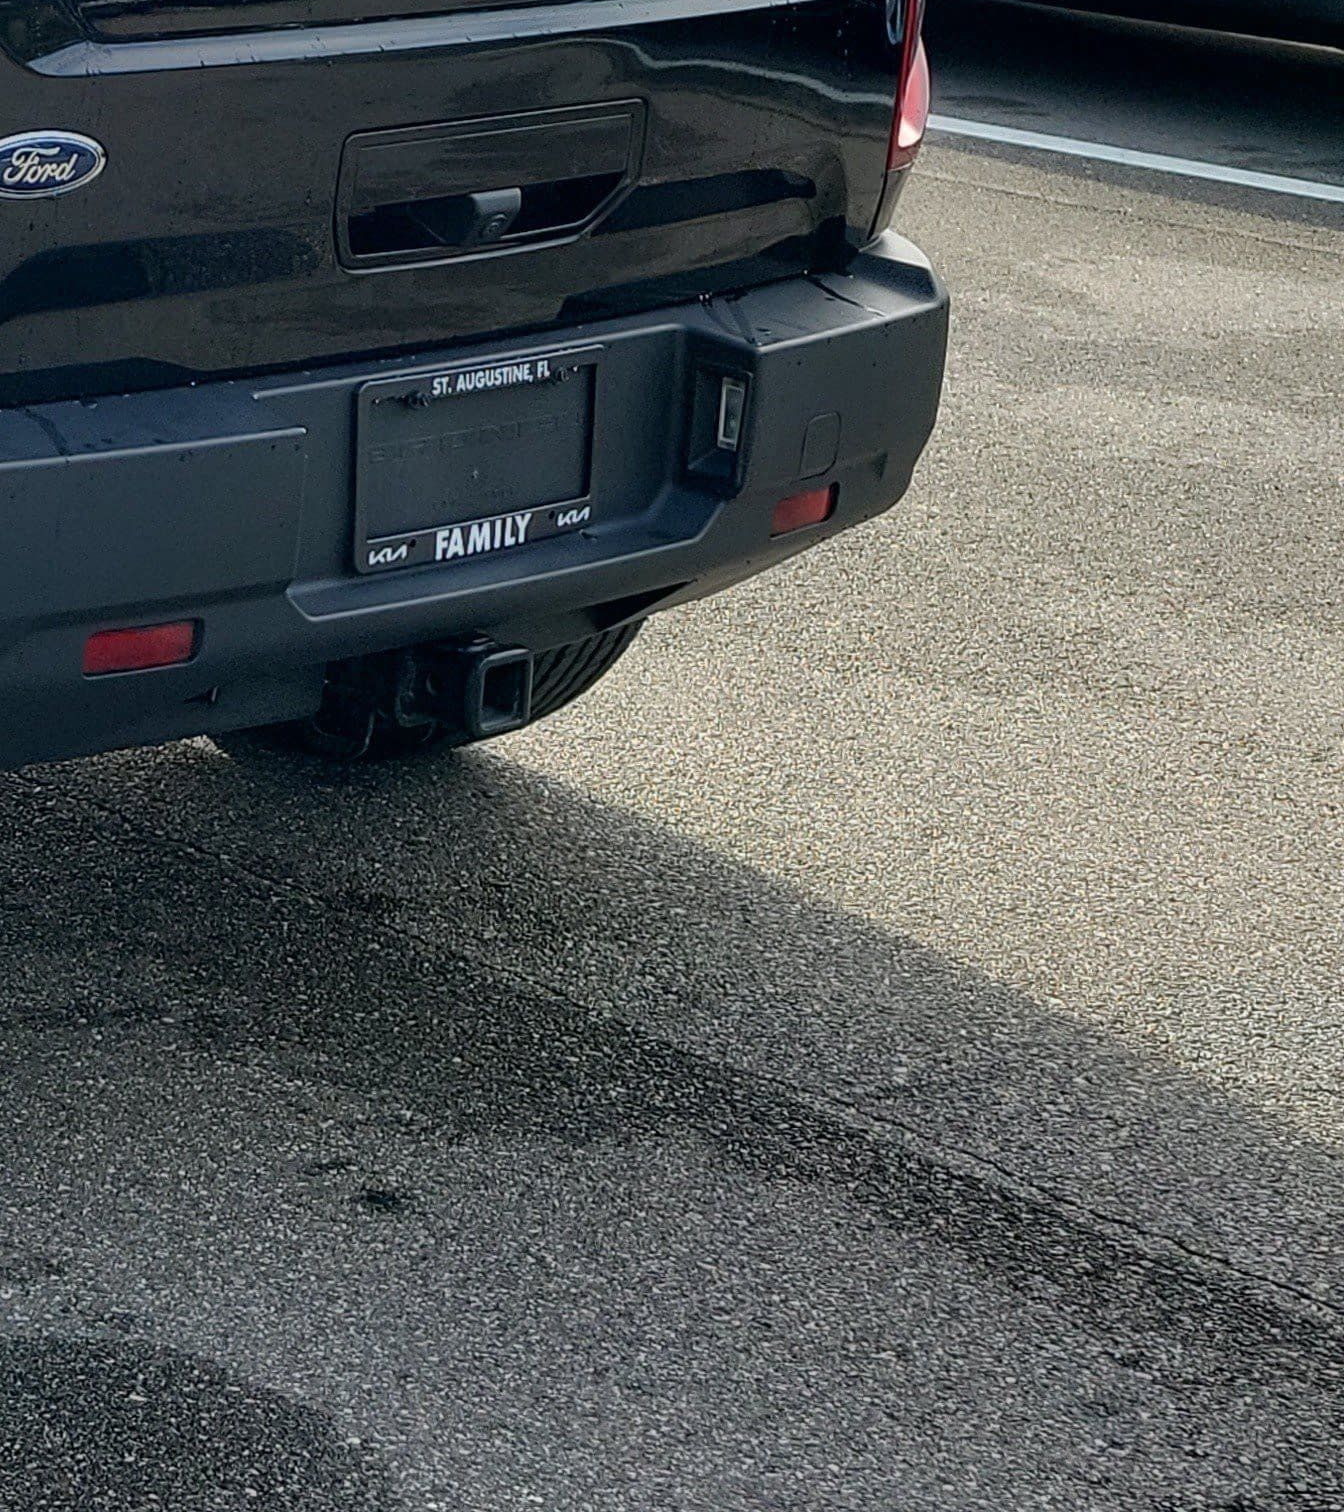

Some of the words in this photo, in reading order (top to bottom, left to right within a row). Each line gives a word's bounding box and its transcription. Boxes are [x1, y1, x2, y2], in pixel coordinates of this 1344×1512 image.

[2, 146, 79, 185] Ford
[431, 377, 452, 396] ST.
[456, 364, 534, 392] AUGUSTINE,
[536, 360, 551, 378] FL
[368, 544, 408, 566] KIA
[434, 513, 533, 561] FAMILY
[556, 506, 591, 528] KIA
